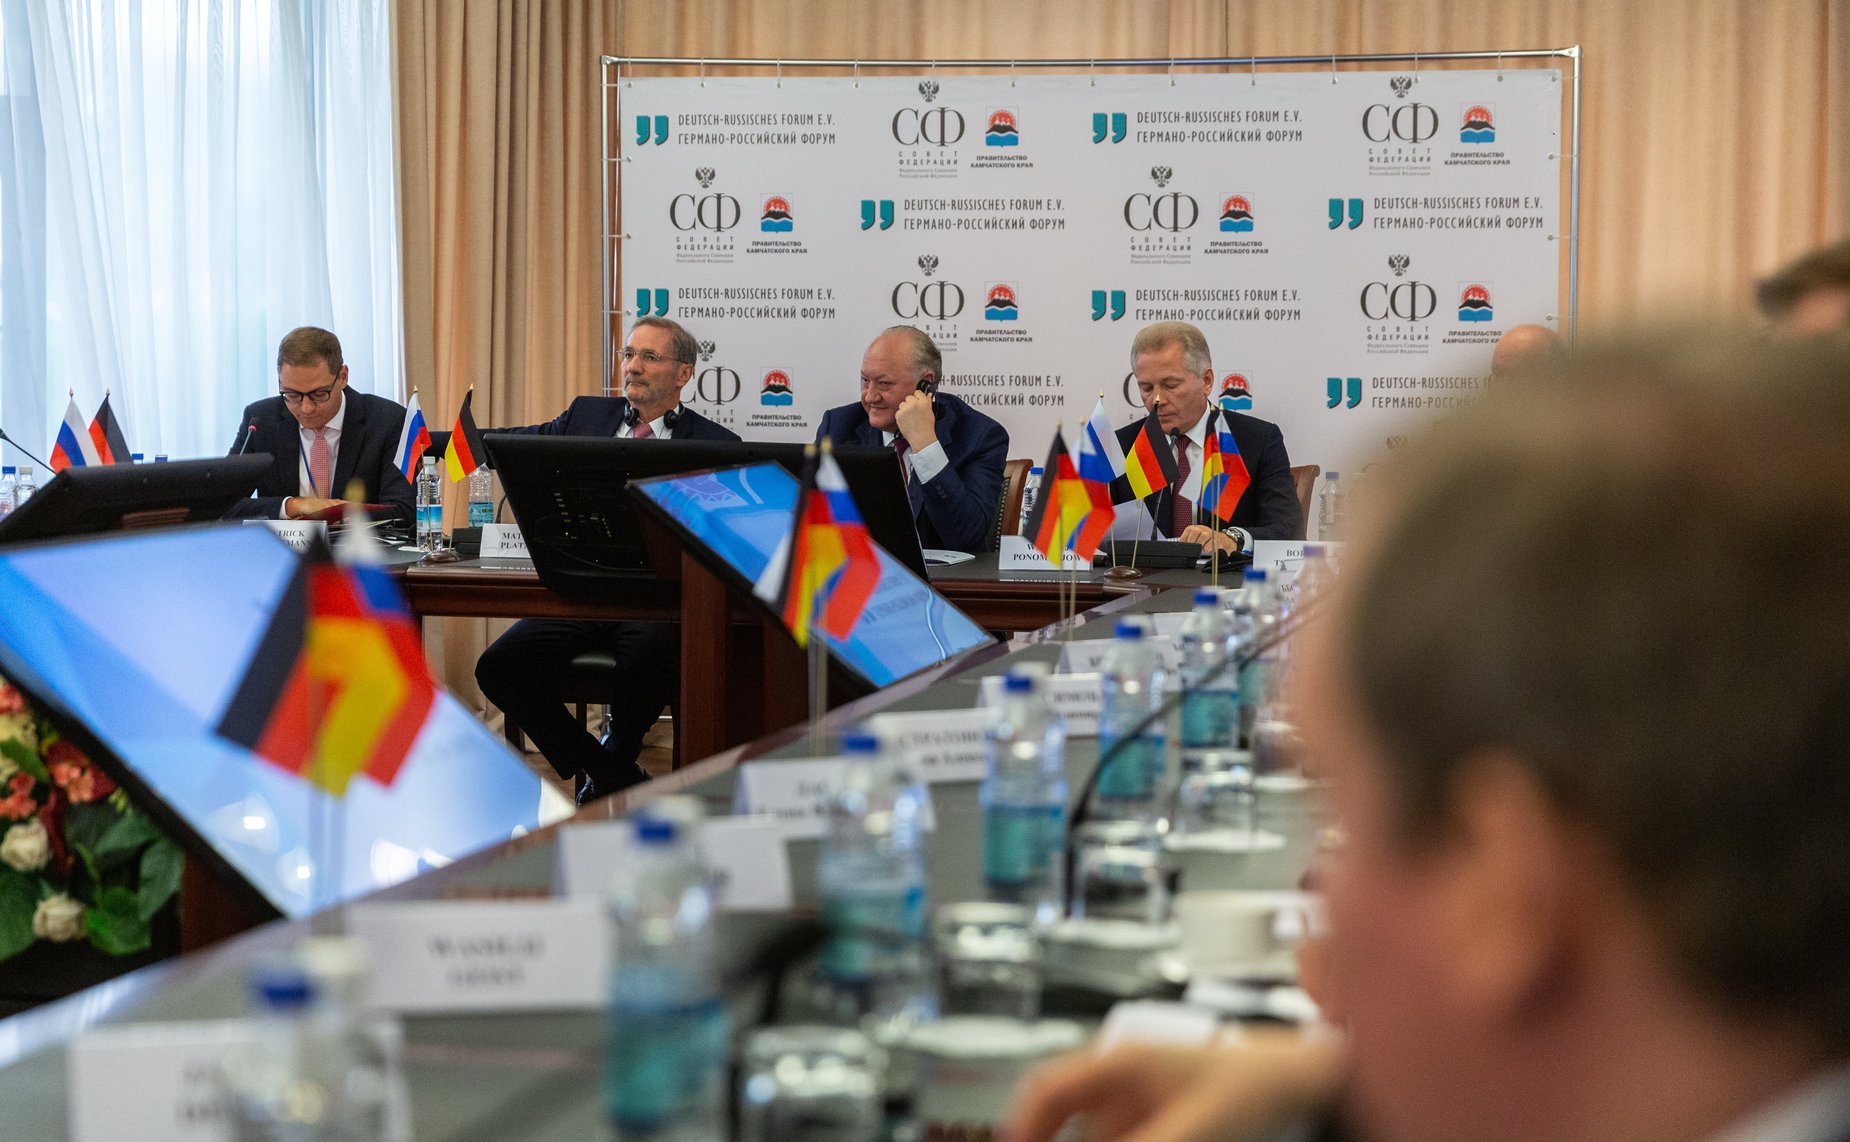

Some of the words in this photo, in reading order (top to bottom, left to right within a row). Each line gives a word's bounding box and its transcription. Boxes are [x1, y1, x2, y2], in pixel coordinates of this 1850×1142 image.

[679, 114, 777, 126] DEUTSCH-RUSSISCHES
[782, 114, 813, 125] FORUM
[818, 114, 834, 125] E.V.
[1137, 110, 1242, 123] DEUTSCH-RUSSISCHES
[1246, 110, 1279, 122] FORUM
[1284, 110, 1302, 122] E.V.
[1362, 103, 1439, 144] СФ
[892, 106, 965, 147] СФ
[679, 131, 796, 145] ГЕРМАНО-РОССИЙСКИЙ
[801, 133, 835, 145] ФОРУМ
[1137, 128, 1261, 143] ГЕРМАНО-РОССИЙСКИЙ
[1266, 130, 1302, 142] ФОРУМ
[904, 199, 1005, 211] DEUTSCH-RUSSISCHES
[1010, 199, 1042, 211] FORUM
[1047, 199, 1064, 211] E.V.
[1374, 197, 1480, 209] DEUTSCH-RUSSISCHES
[1486, 197, 1519, 209] FORUM
[1525, 197, 1543, 209] E.V.
[670, 192, 741, 233] СФ
[1124, 191, 1199, 233] СФ
[904, 216, 1025, 230] ГЕРМАНО-РОССИЙСКИЙ
[1029, 218, 1065, 230] ФОРУМ
[1374, 215, 1501, 229] ГЕРМАНО-РОССИЙСКИЙ
[1506, 217, 1543, 229] ФОРУМ
[679, 288, 777, 300] DEUTSCH-RUSSISCHES
[782, 288, 813, 300] FORUM
[818, 288, 835, 300] E.V.
[892, 280, 965, 321] СФ
[1136, 289, 1240, 301] DEUTSCH-RUSSISCHES
[1244, 289, 1278, 301] FORUM
[1283, 289, 1300, 301] E.V.
[1360, 281, 1437, 322] СФ
[679, 305, 796, 319] ГЕРМАНО-РОССИЙСКИЙ
[801, 307, 835, 319] ФОРУМ
[1136, 306, 1260, 321] ГЕРМАНО-РОССИЙСКИЙ
[1265, 308, 1300, 320] ФОРУМ
[1009, 375, 1042, 387] FORUM
[1046, 376, 1064, 387] E.V.
[1372, 377, 1479, 389] DEUTSCH-RUSSISCHES
[1029, 395, 1064, 407] ФОРУМ
